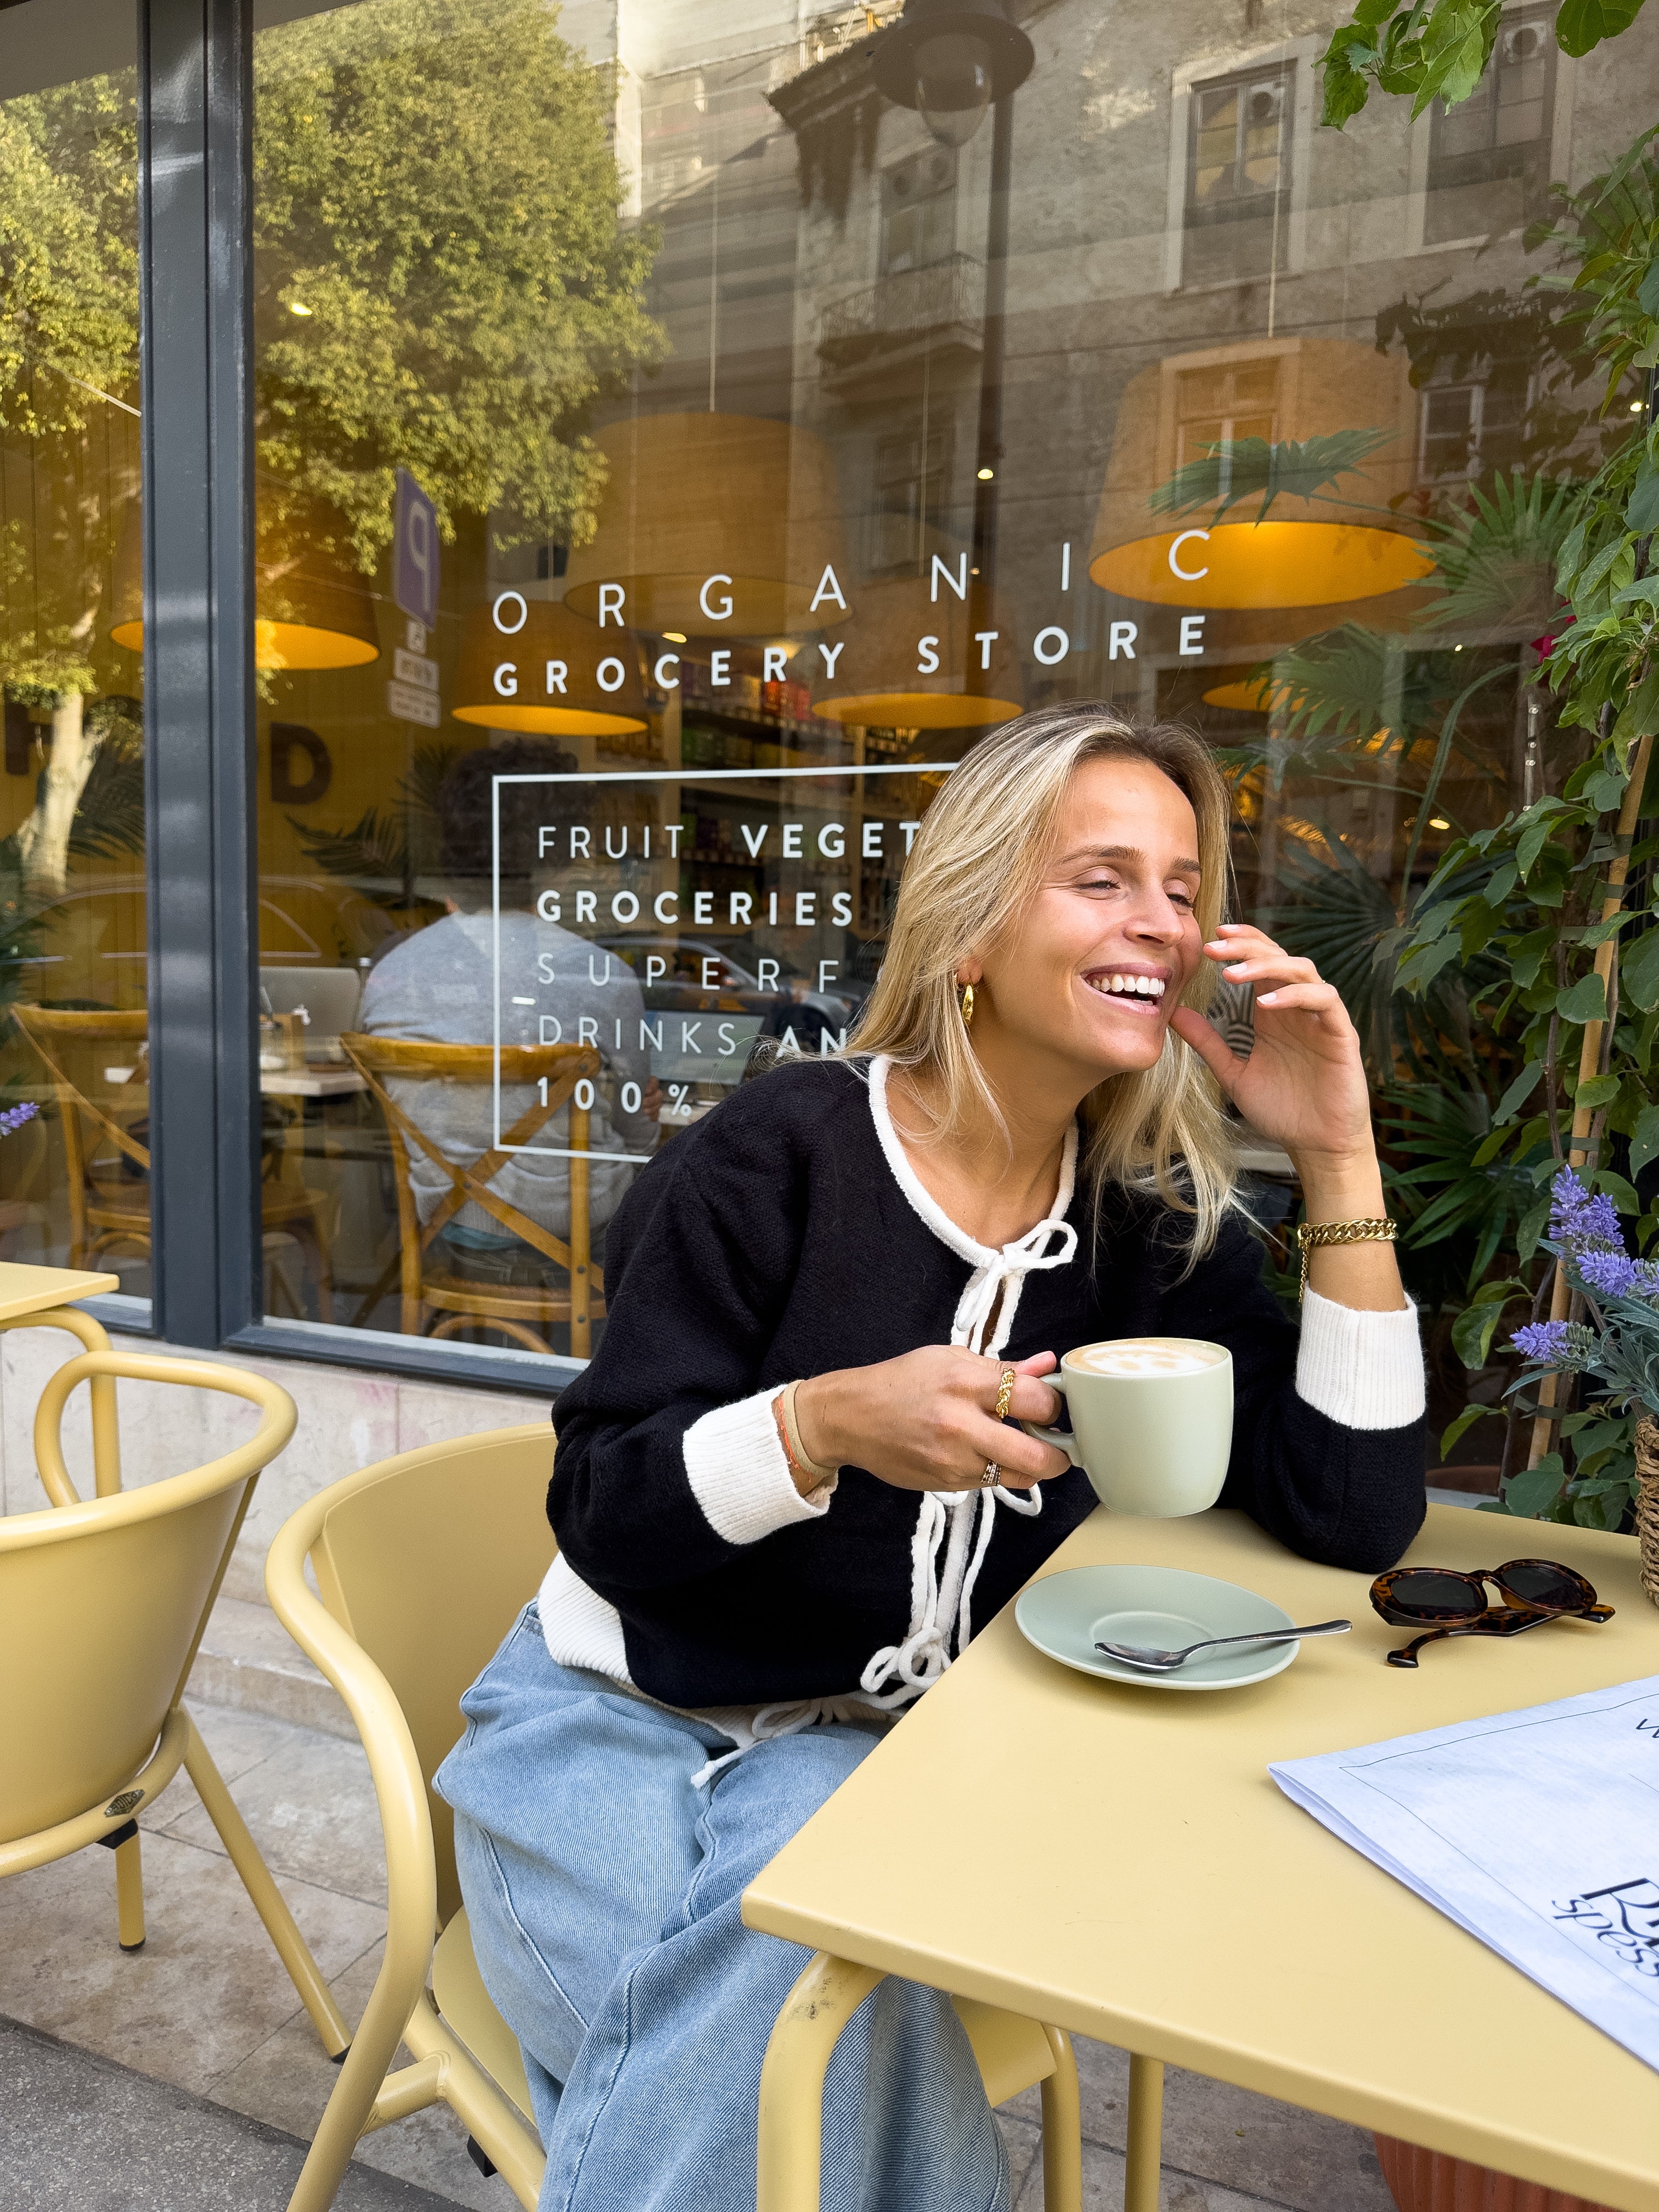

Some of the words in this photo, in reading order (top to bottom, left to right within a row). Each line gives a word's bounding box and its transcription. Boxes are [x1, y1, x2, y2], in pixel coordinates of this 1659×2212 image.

[492, 529, 1210, 635] ORGANIC
[493, 642, 845, 697] GROCERY
[917, 614, 1206, 674] STORE
[538, 825, 685, 860] FRUIT
[536, 889, 853, 927] GROCERIES
[537, 952, 840, 994] SUPERF
[538, 1014, 737, 1056] DRINKS
[536, 1076, 693, 1118] 100%
